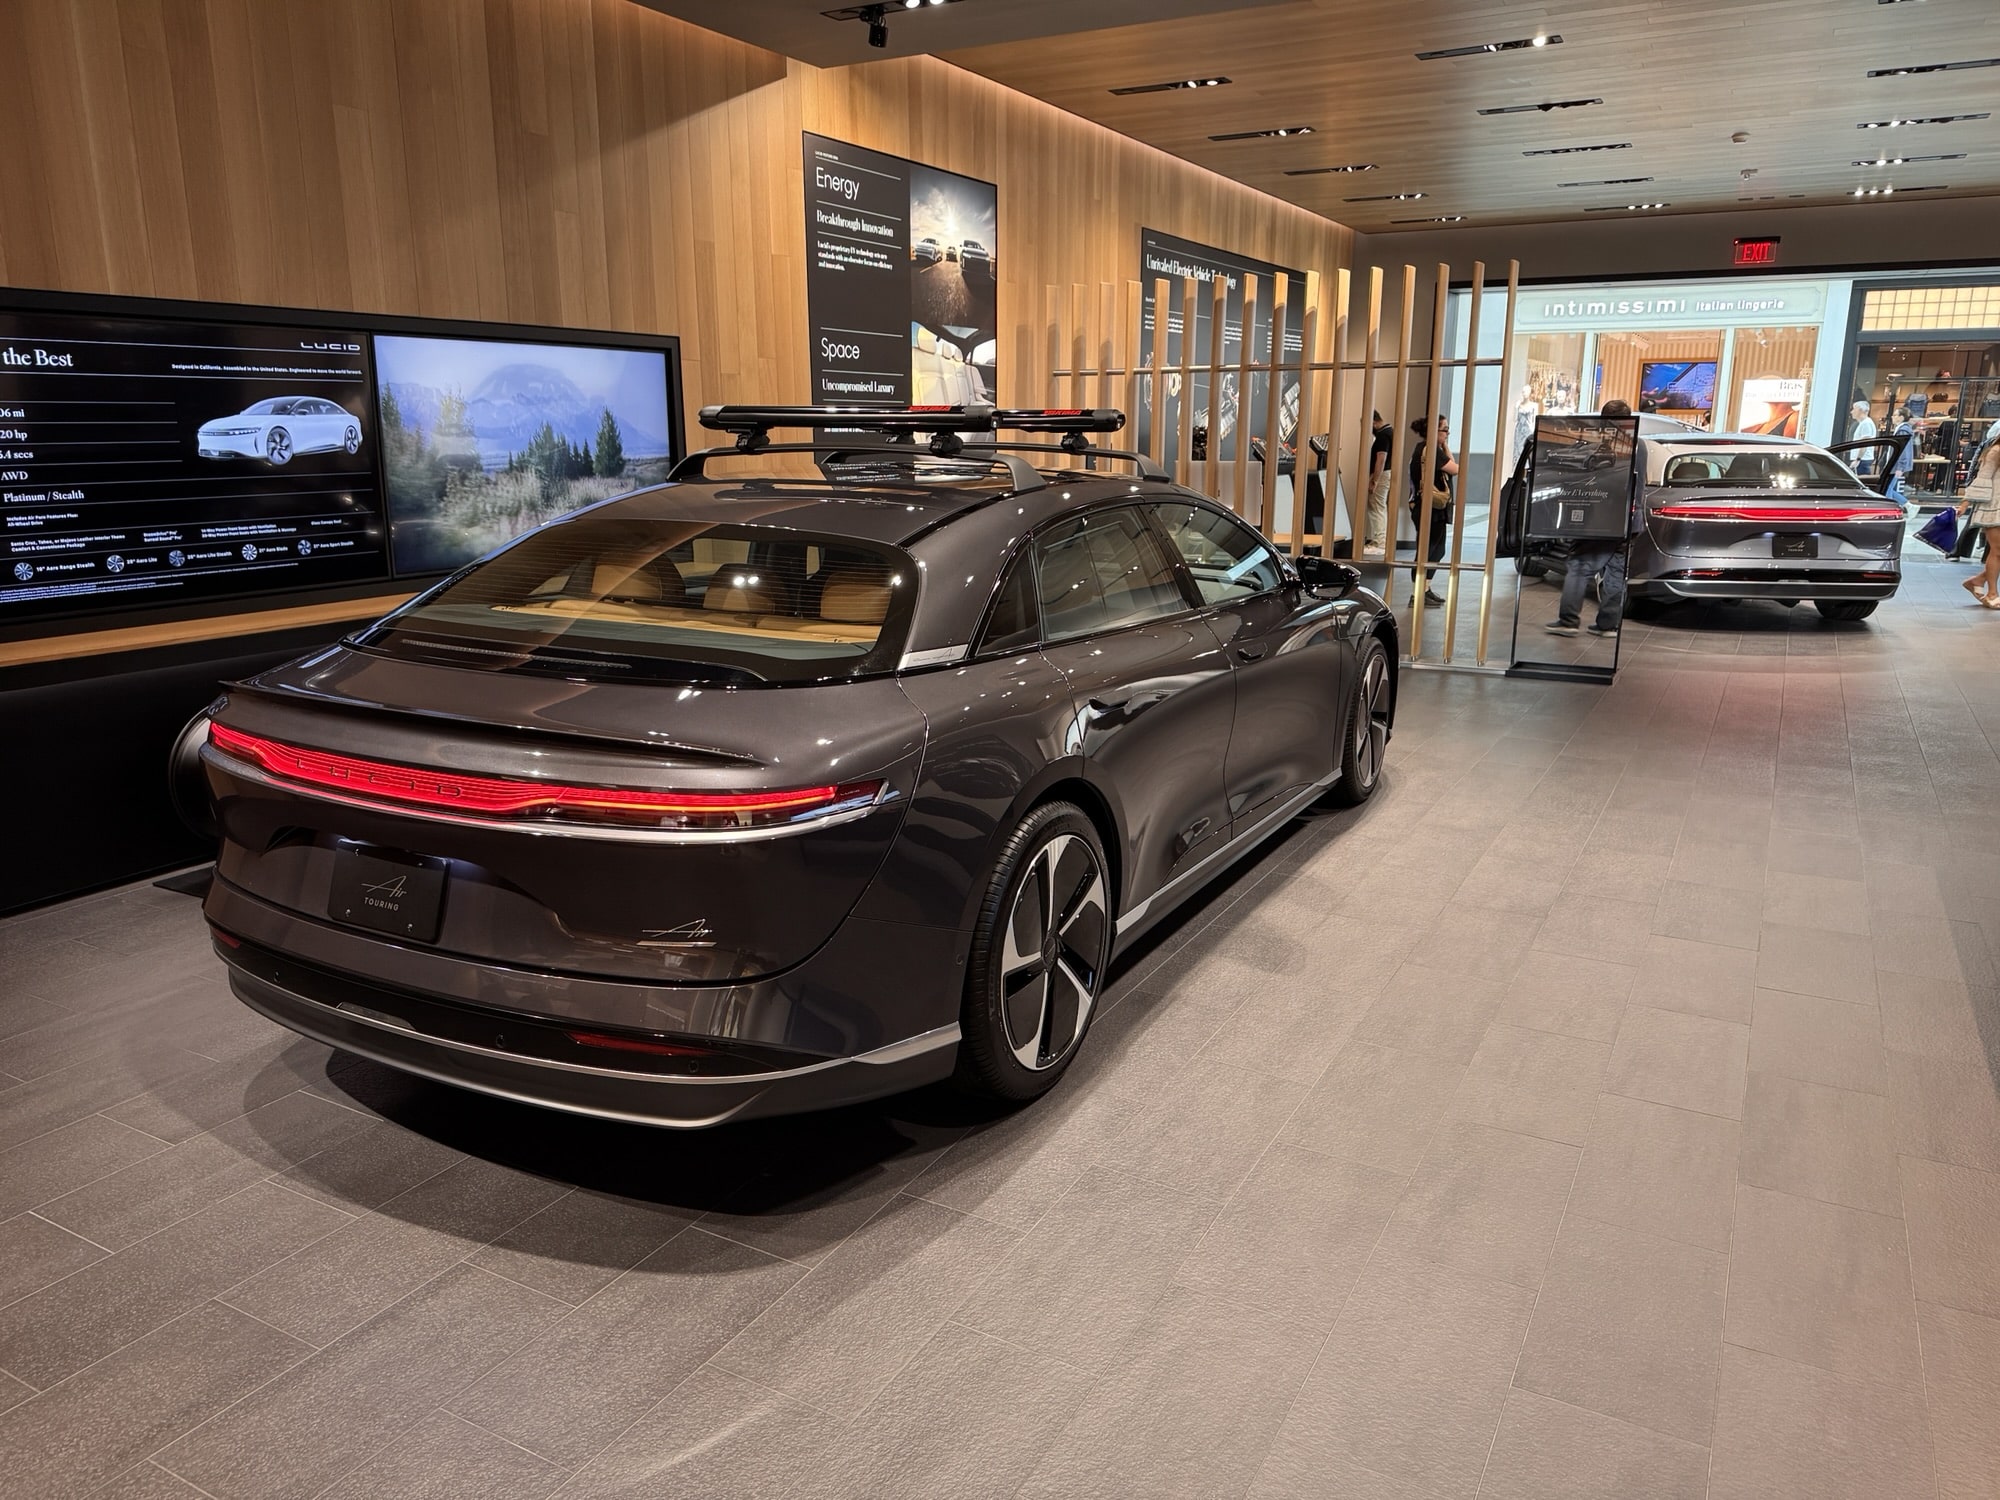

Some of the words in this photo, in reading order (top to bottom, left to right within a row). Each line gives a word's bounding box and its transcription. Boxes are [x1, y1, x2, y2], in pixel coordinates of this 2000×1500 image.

[816, 166, 860, 201] Energy
[816, 209, 861, 232] Breakthrough
[861, 219, 894, 238] Innovation
[1742, 242, 1771, 261] EXIT
[1146, 253, 1173, 274] Unrivaled
[1173, 260, 1193, 279] Electric
[1193, 265, 1211, 282] Vehicle
[1544, 299, 1686, 318] intimissimi
[1737, 299, 1785, 314] lingerie
[300, 342, 361, 351] LUCID
[821, 337, 860, 362] Space
[2, 347, 32, 366] the
[34, 348, 74, 367] Best
[821, 378, 873, 394] Uncompromised
[873, 381, 896, 395] Luxury
[12, 408, 25, 418] mi
[14, 429, 28, 441] hp
[13, 451, 34, 459] secs
[1, 471, 29, 481] AWD
[3, 493, 46, 503] Platinum
[47, 491, 51, 502] /
[52, 490, 85, 501] Stealth
[295, 757, 463, 797] LUCID
[361, 875, 408, 898] Air
[364, 897, 400, 912] TOURING
[642, 918, 713, 939] Air
